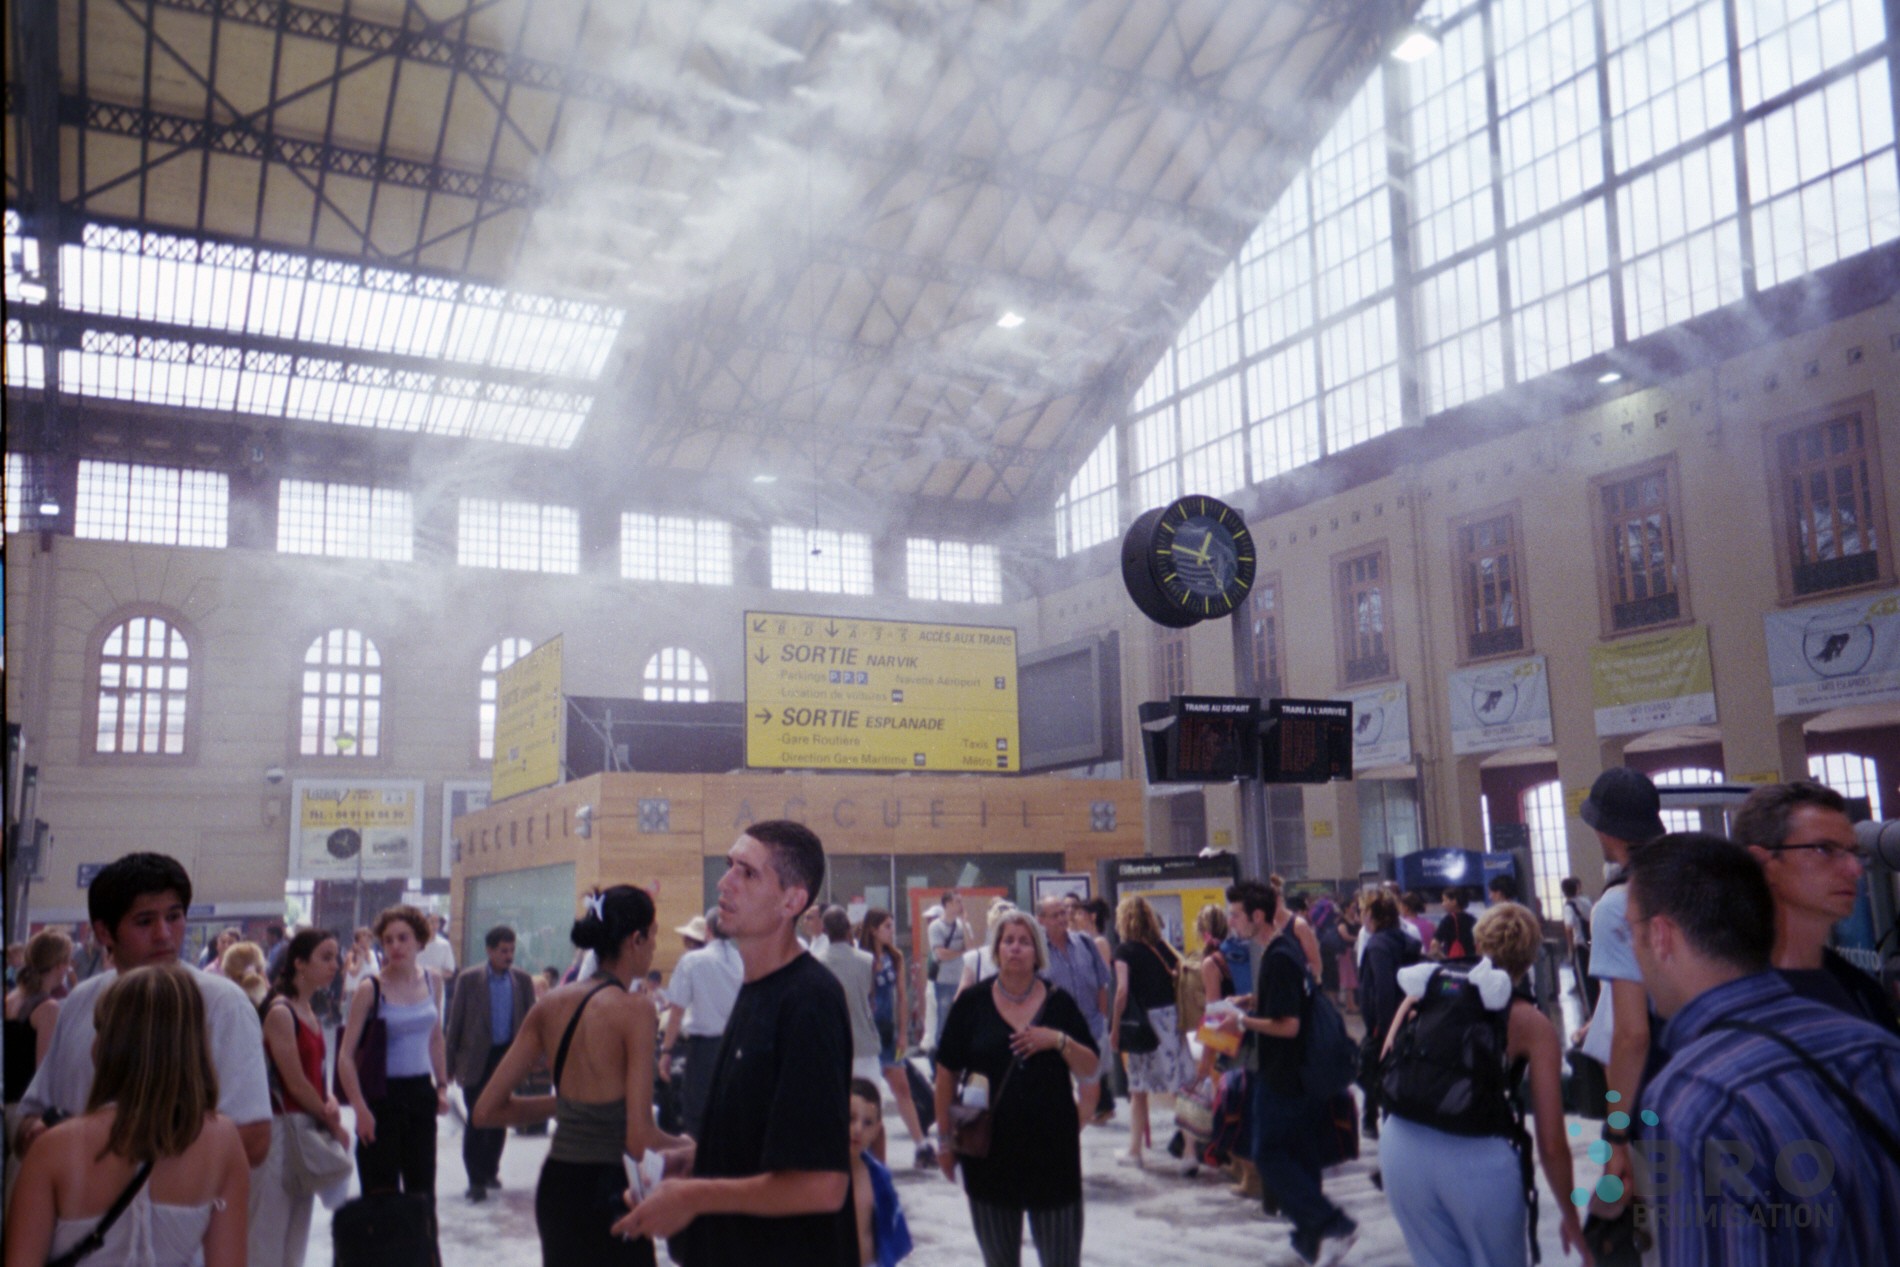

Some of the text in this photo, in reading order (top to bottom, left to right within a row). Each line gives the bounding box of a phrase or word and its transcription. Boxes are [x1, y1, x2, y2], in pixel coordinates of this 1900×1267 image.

[953, 633, 975, 645] AUX
[978, 634, 1012, 646] TRAINS
[780, 643, 919, 669] SORTIE NARVIK
[780, 669, 826, 683] Parkings
[895, 674, 981, 689] Navette Aéroport
[780, 687, 887, 702] Location de voitures
[1185, 703, 1209, 712] TRAINS
[1211, 704, 1220, 712] AU
[1281, 705, 1305, 714] TRAINS
[781, 706, 946, 731] SORTIE ESPLANADE
[781, 732, 860, 746] Gare Routière
[962, 738, 988, 749] Taxis
[781, 752, 908, 765] Direction Gare Maritime
[962, 755, 992, 766] Métro
[733, 798, 1032, 829] ACCUEIL
[1119, 863, 1162, 875] Billetterie
